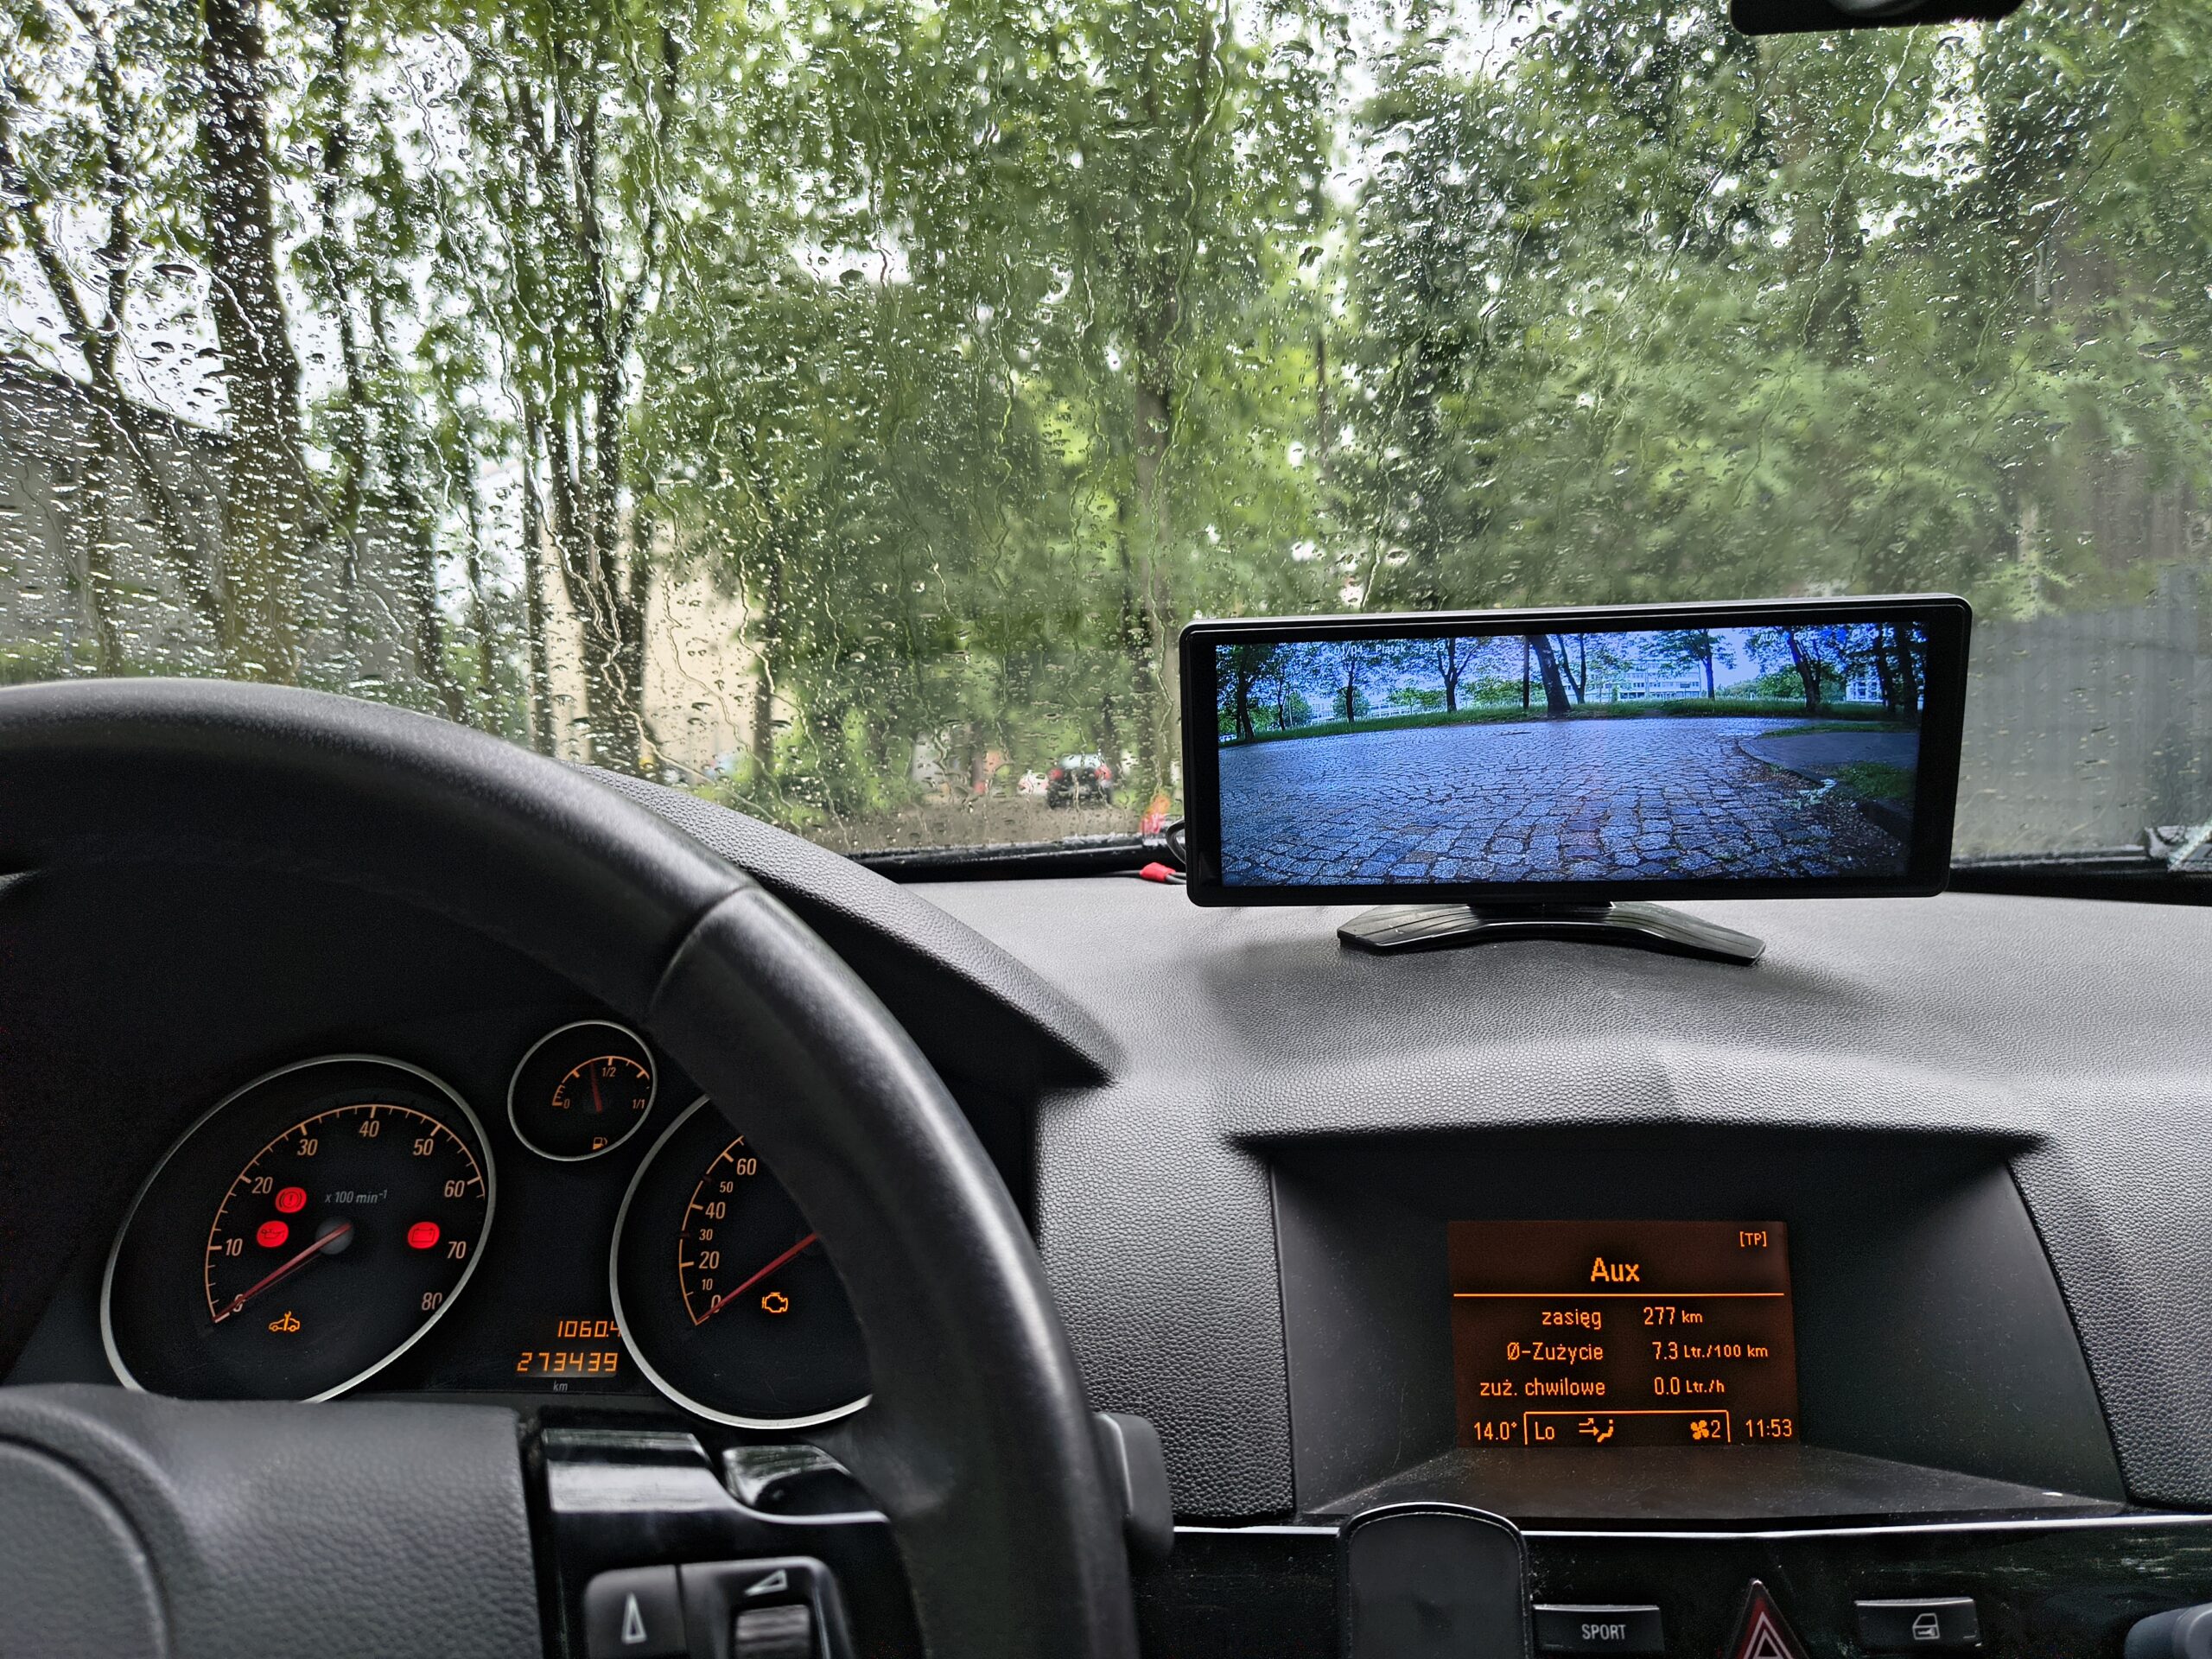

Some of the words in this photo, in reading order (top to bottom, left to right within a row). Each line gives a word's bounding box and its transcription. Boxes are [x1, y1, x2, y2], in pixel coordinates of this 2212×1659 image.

[359, 1121, 380, 1138] 40
[297, 1139, 318, 1156] 30
[413, 1139, 434, 1156] 50
[736, 1158, 757, 1176] 60
[251, 1177, 273, 1194] 20
[444, 1180, 465, 1198] 60
[720, 1182, 734, 1193] 50
[335, 1191, 354, 1204] 100
[705, 1201, 726, 1219] 40
[699, 1230, 713, 1241] 30
[1739, 1231, 1767, 1248] [TP]
[226, 1238, 243, 1256] 10
[448, 1242, 466, 1259] 70
[699, 1252, 720, 1269] 20
[1590, 1257, 1640, 1282] Aux
[702, 1278, 713, 1290] 10
[422, 1292, 442, 1311] 80
[1541, 1309, 1602, 1330] zasięg
[1643, 1306, 1675, 1325] 277
[1681, 1310, 1703, 1324] km
[1652, 1342, 1678, 1359] 7.3
[1747, 1344, 1768, 1357] km
[517, 1351, 619, 1372] 273439
[553, 1381, 568, 1391] km
[1480, 1379, 1517, 1396] zuż.
[1525, 1377, 1605, 1396] chwilowe
[1654, 1377, 1681, 1395] 0.0
[1686, 1379, 1725, 1394] Ltr./h
[1535, 1422, 1555, 1440] Lo
[1710, 1421, 1721, 1438] 2
[1745, 1419, 1793, 1438] 11:53
[1581, 1624, 1626, 1640] SPORT
